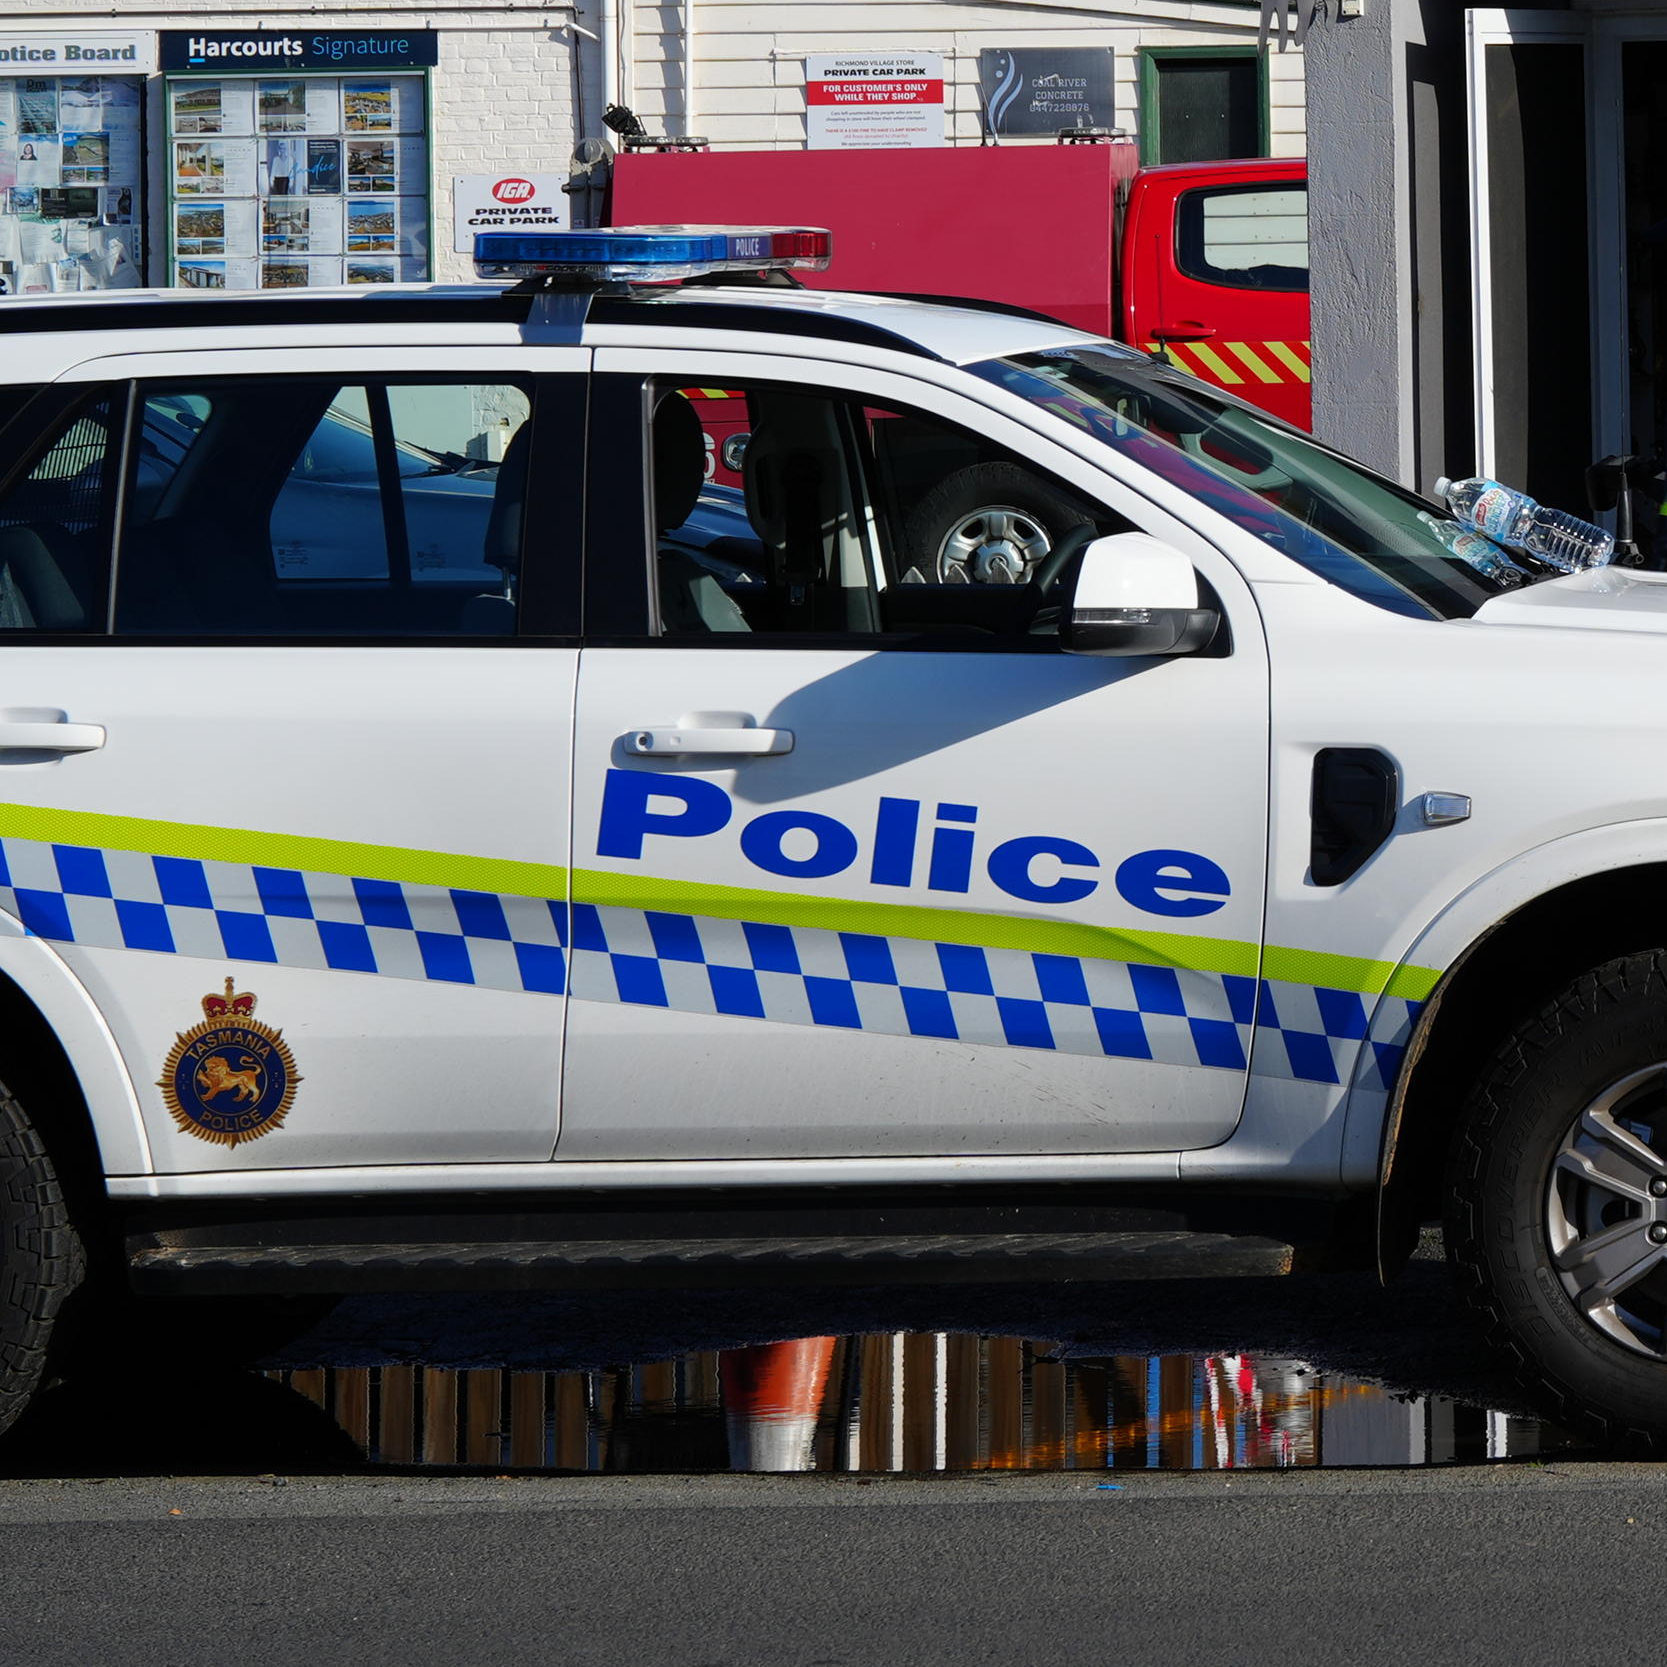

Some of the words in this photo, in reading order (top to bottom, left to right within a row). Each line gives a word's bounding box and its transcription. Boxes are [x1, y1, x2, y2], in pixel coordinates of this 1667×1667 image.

[64, 44, 136, 61] Board
[189, 37, 303, 57] Harcourts
[312, 36, 409, 60] Signature
[823, 85, 842, 93] FOR
[843, 84, 902, 92] CUSTOMER'S
[904, 83, 928, 91] ONLY
[1032, 78, 1055, 87] COAL
[1058, 78, 1087, 87] RIVER
[867, 93, 889, 101] THEY
[1035, 91, 1084, 100] CONCRETE
[475, 207, 552, 216] PRIVATE
[509, 216, 560, 224] PARK
[735, 238, 761, 256] POLICE
[596, 768, 1231, 918] Police
[186, 1030, 272, 1061] TASMANIA
[199, 1109, 264, 1131] POLICE
